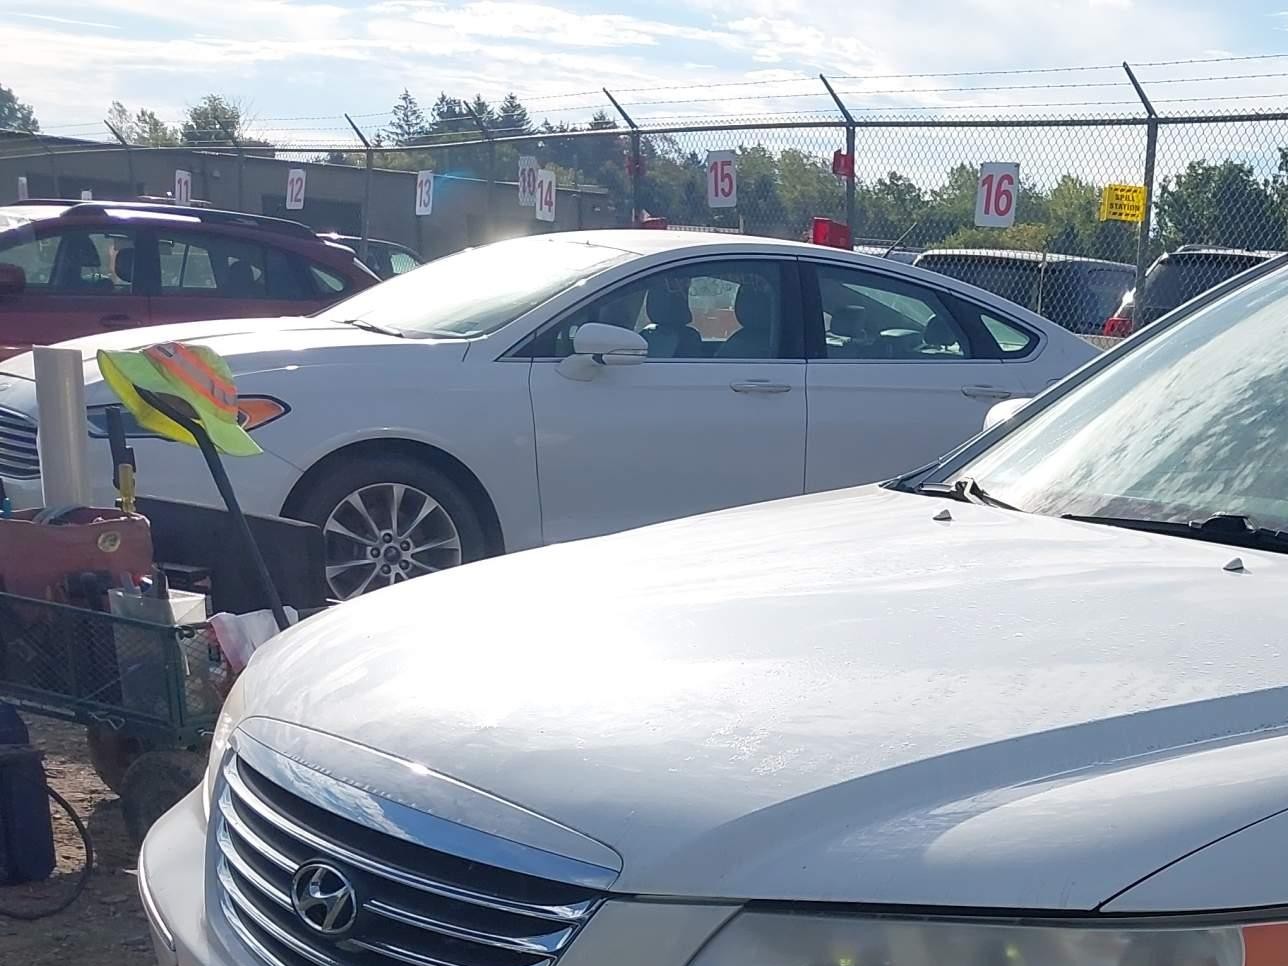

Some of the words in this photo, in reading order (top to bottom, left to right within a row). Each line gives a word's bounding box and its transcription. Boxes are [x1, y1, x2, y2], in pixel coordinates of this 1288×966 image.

[177, 177, 190, 203] 11
[288, 177, 303, 203] 12
[709, 160, 734, 198] 15
[418, 179, 432, 208] 13
[537, 180, 553, 212] 14
[981, 173, 1014, 217] 16
[1115, 193, 1135, 202] SPILL
[1109, 203, 1140, 212] STATION
